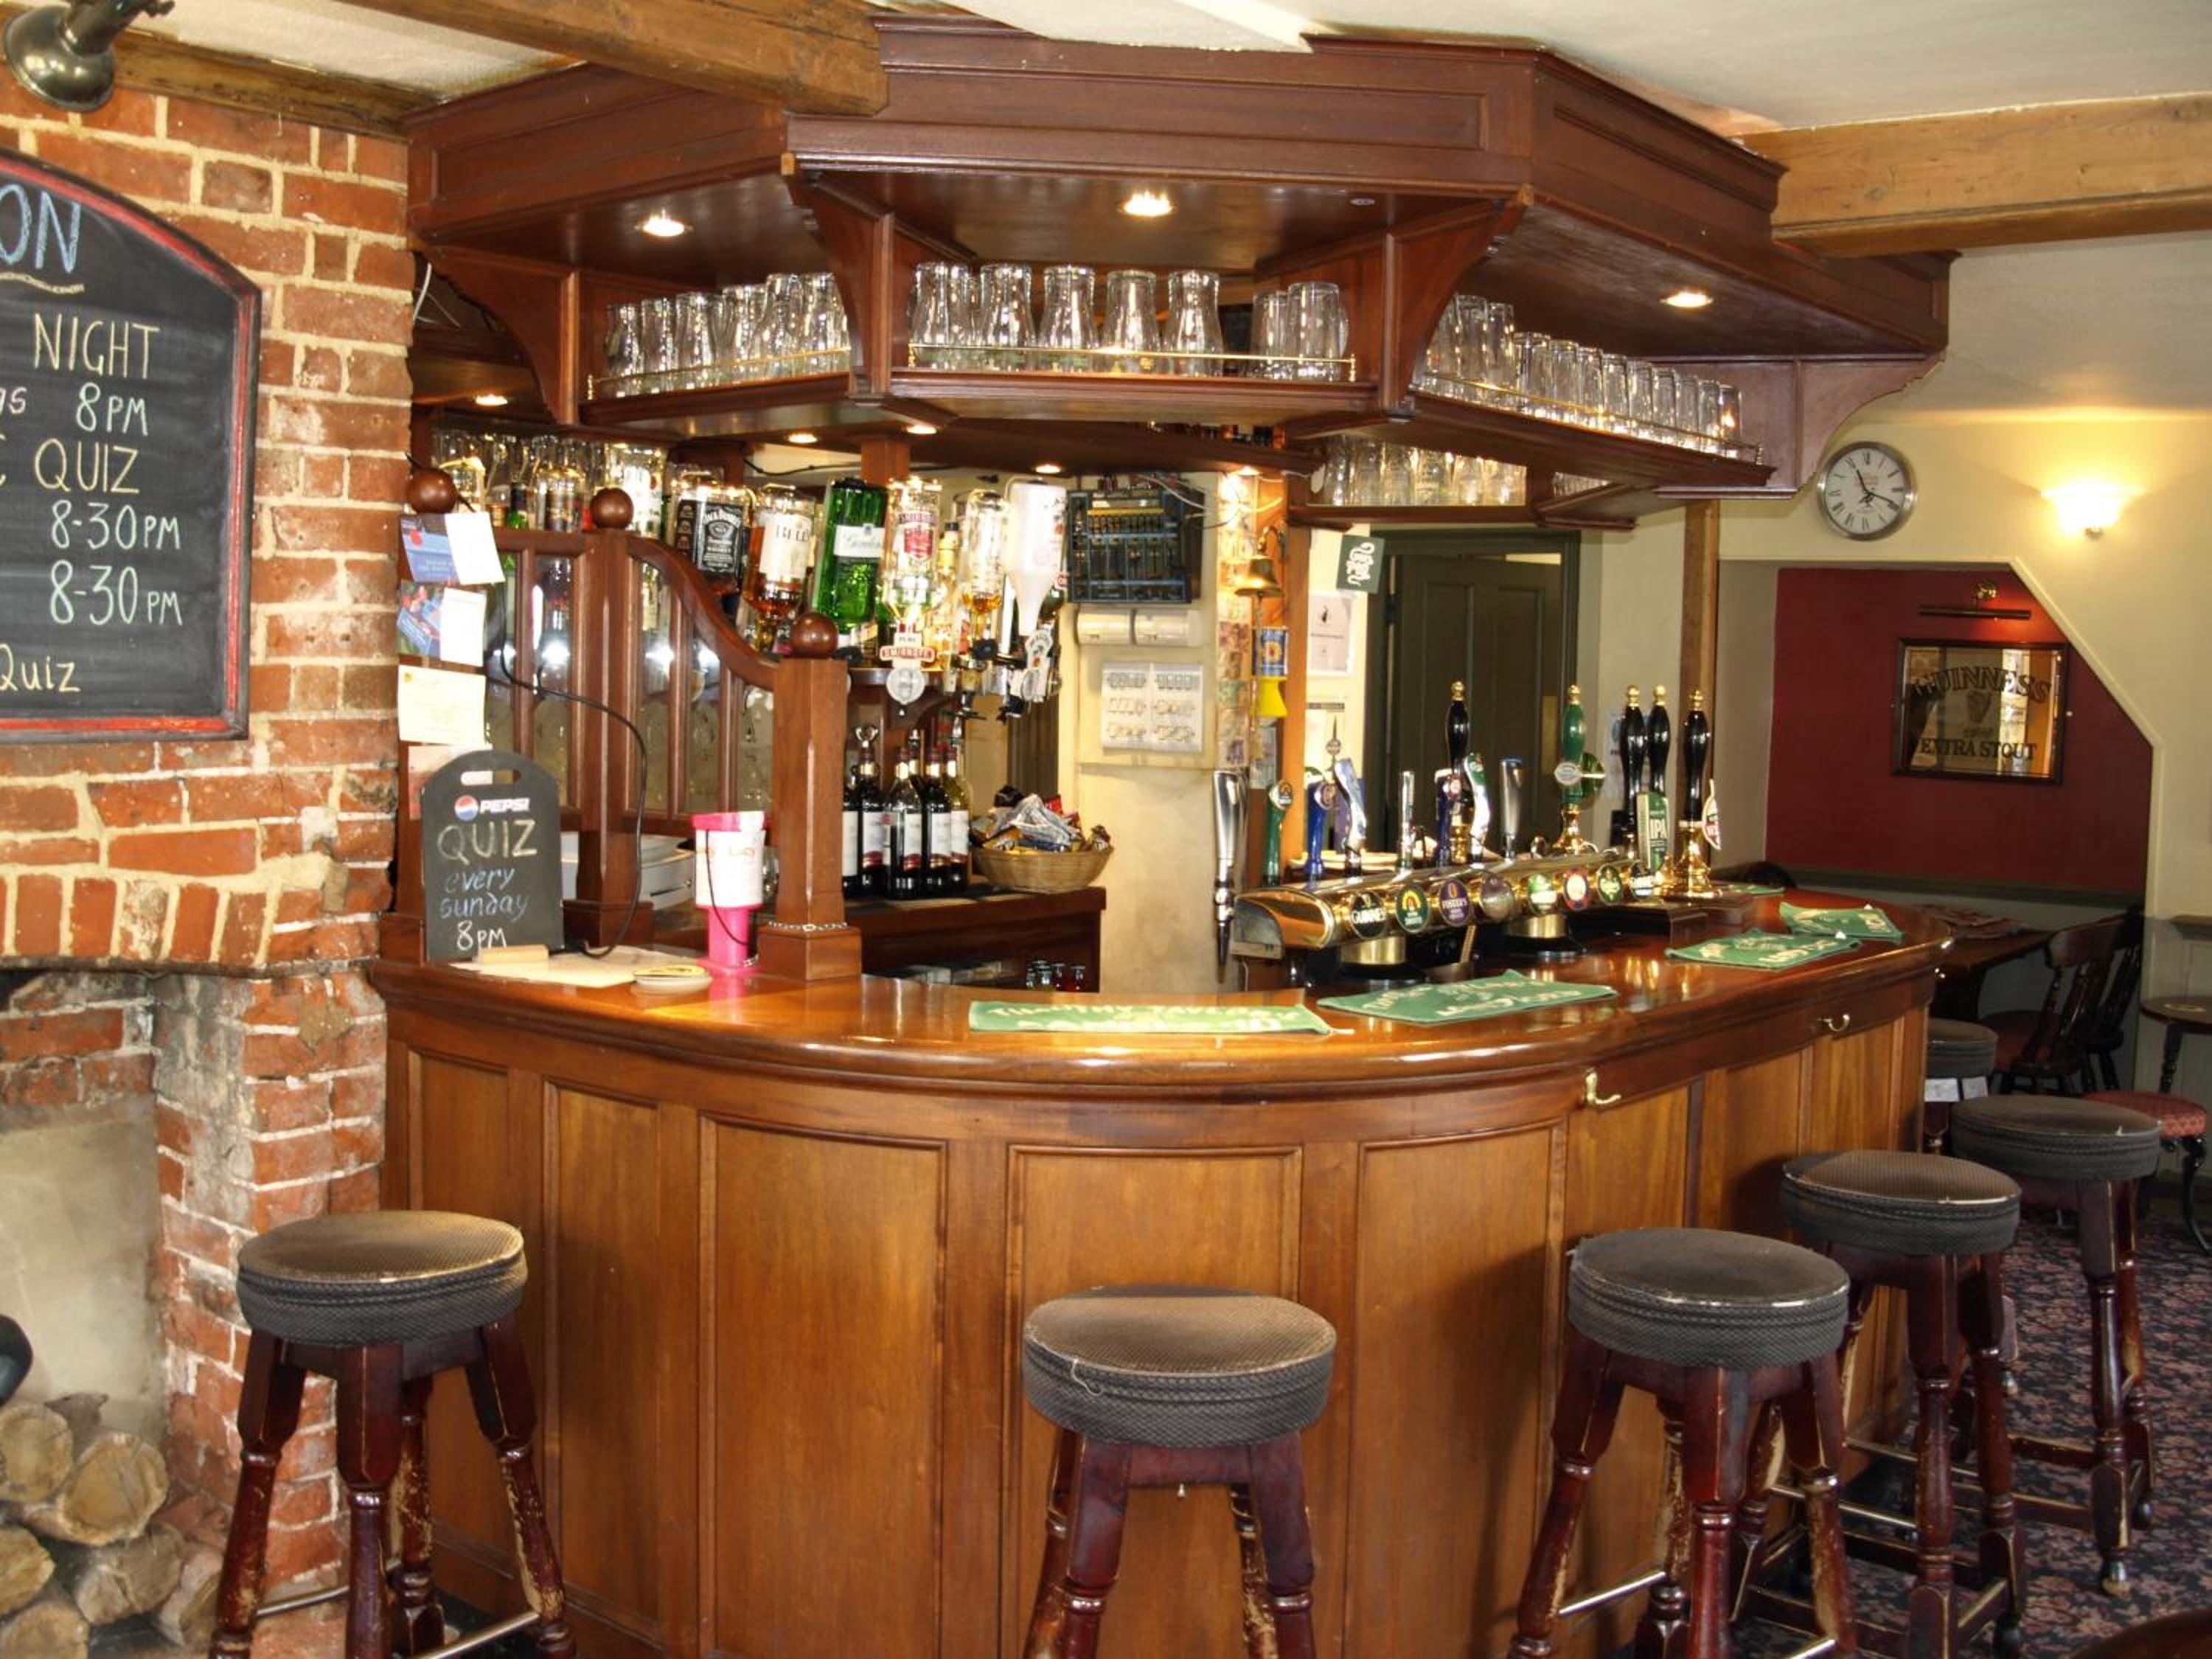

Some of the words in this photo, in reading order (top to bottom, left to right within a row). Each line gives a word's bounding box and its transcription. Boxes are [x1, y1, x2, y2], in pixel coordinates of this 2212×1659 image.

[34, 312, 161, 380] NIGHT
[35, 438, 140, 494] QUIZ
[1911, 666, 2053, 704] GUINNESS
[1979, 740, 2037, 760] STOUT
[480, 797, 530, 815] PEPSI
[437, 818, 538, 866] QUIZ
[1649, 818, 1667, 840] IPA
